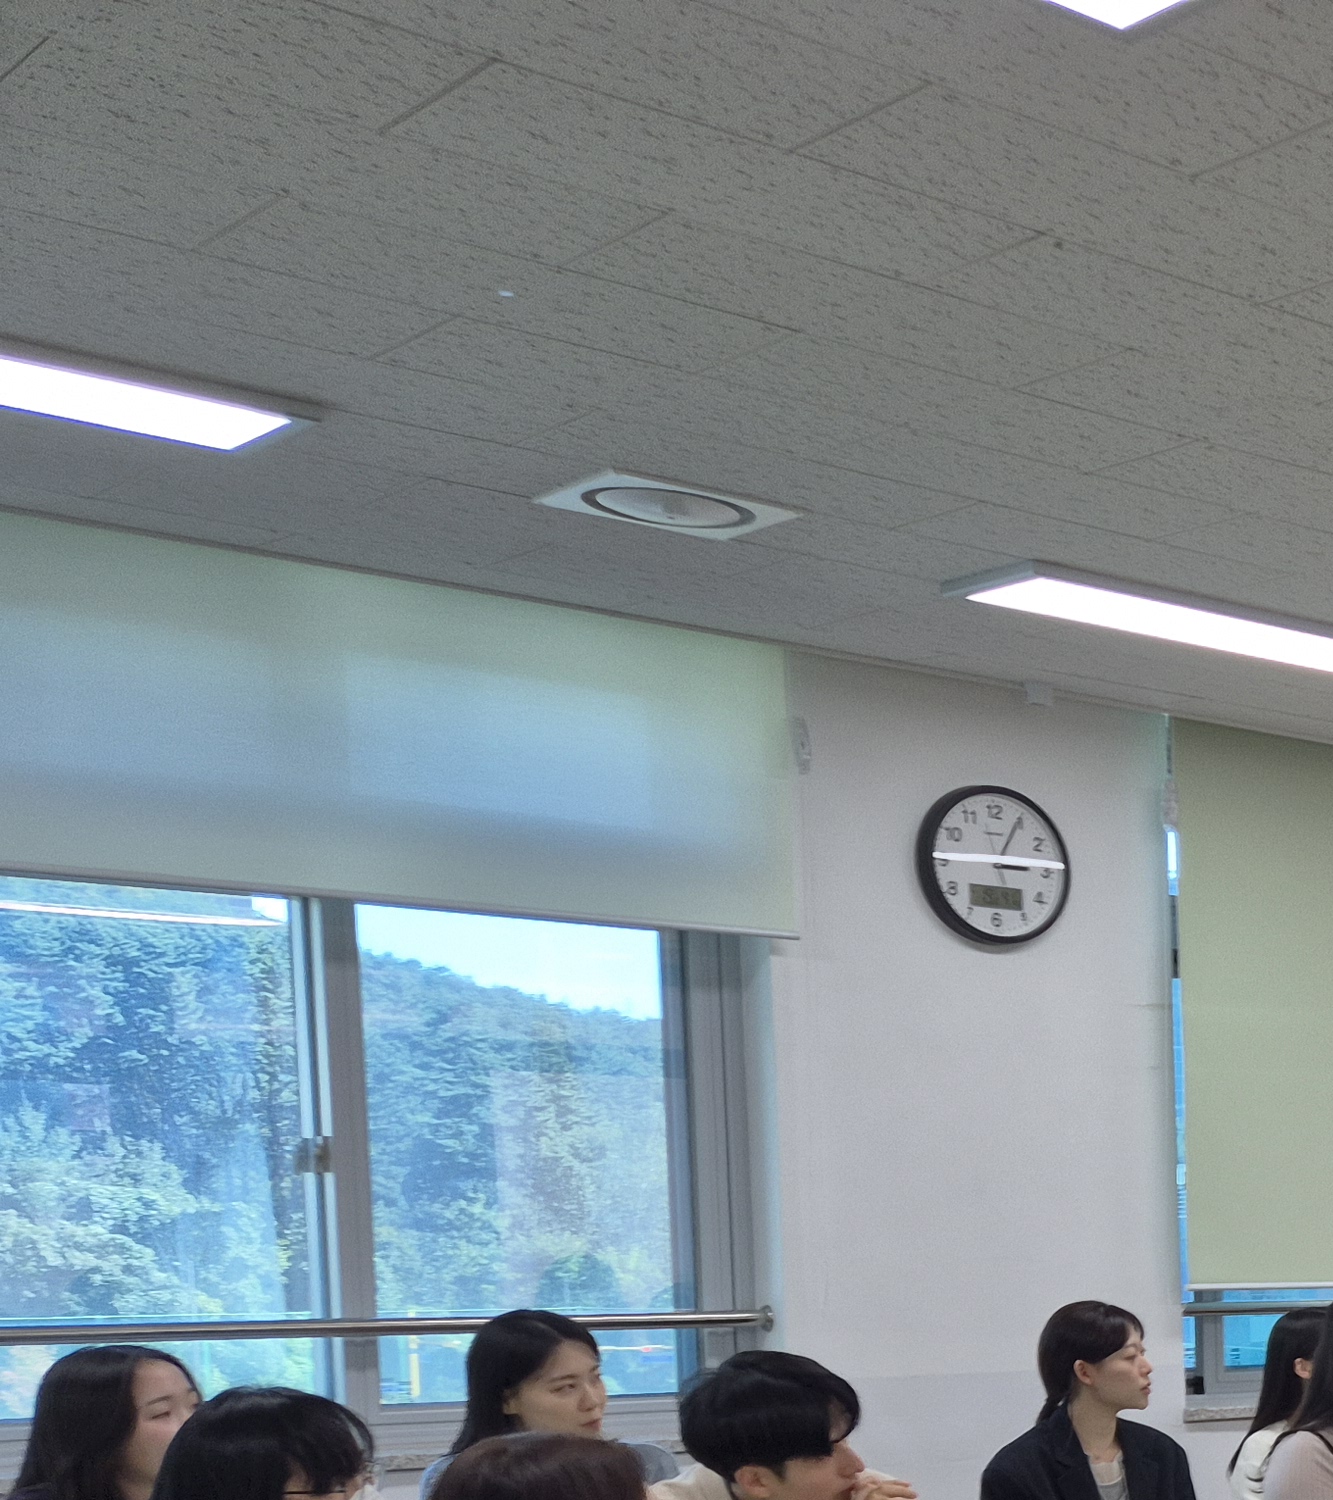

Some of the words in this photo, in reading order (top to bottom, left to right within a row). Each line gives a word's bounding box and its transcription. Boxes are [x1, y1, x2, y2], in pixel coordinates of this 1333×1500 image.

[962, 810, 977, 824] 11
[987, 805, 1003, 820] 12
[1033, 837, 1046, 852] 2
[1032, 892, 1048, 904] 4
[991, 913, 1002, 927] 6
